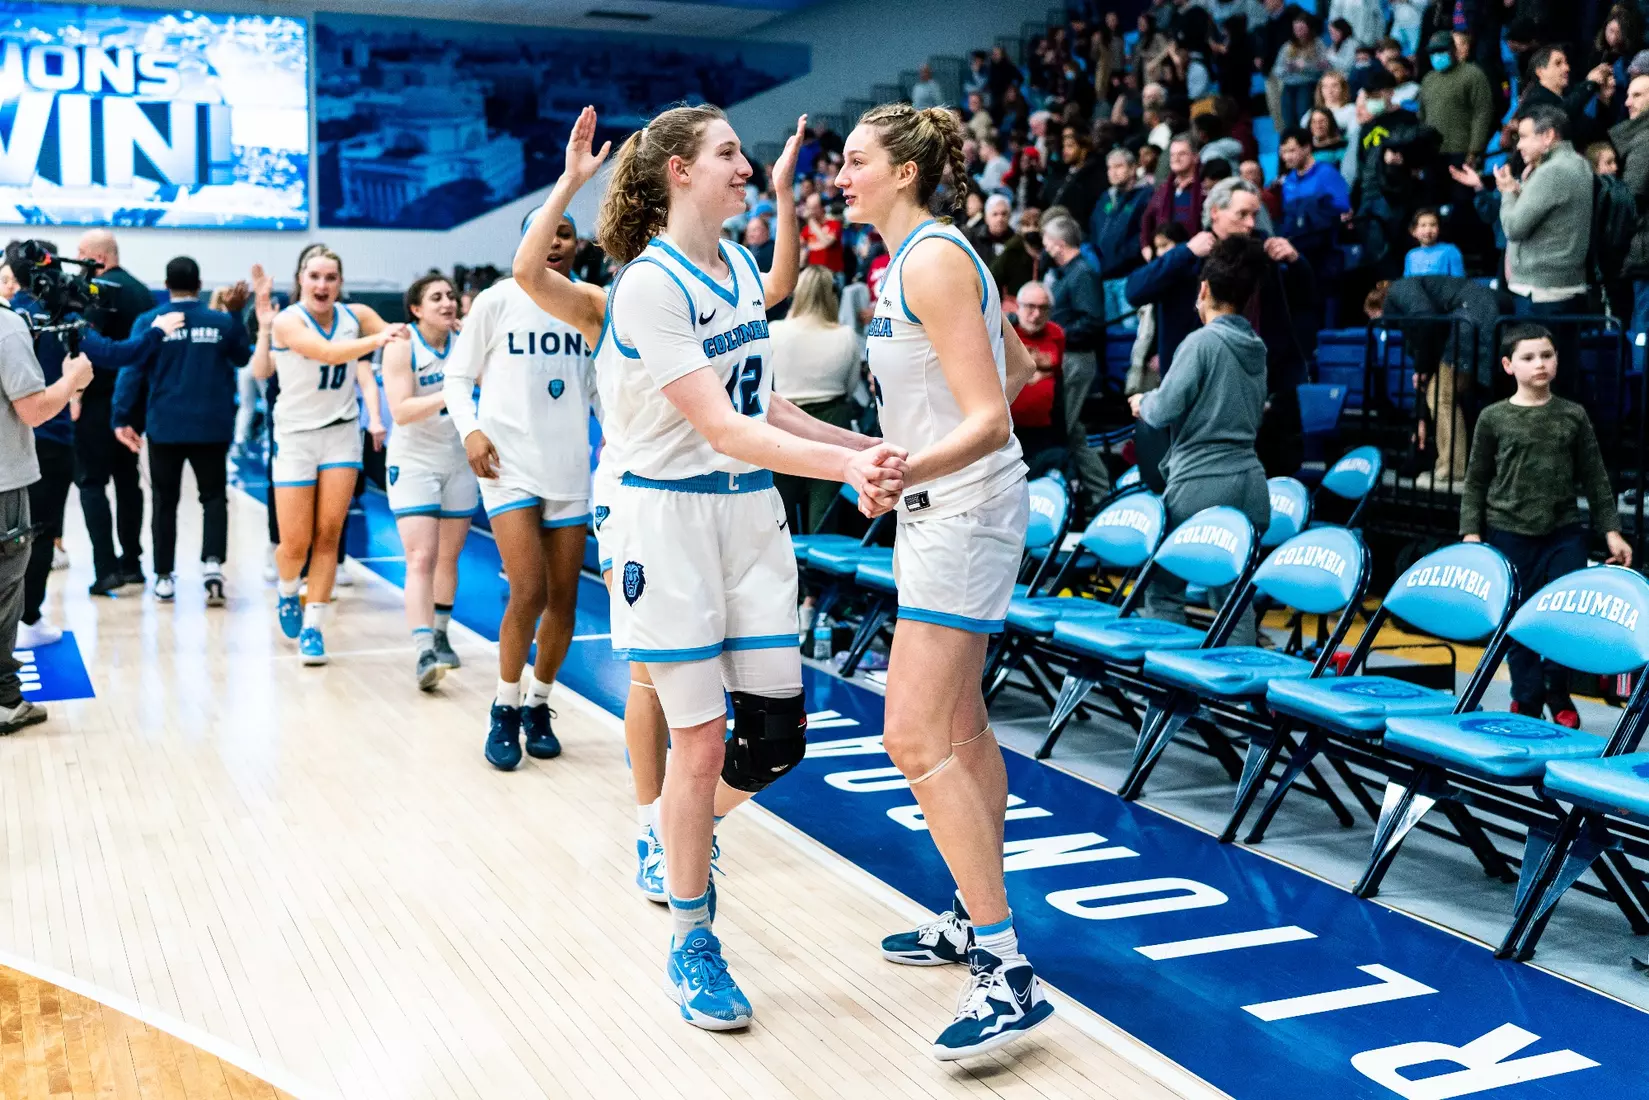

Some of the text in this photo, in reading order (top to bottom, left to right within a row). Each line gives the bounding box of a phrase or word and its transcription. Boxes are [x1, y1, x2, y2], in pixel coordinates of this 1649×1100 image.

[0, 43, 180, 95] IONS
[318, 362, 348, 391] 10
[1096, 509, 1151, 535] COLUMBIA
[1174, 525, 1239, 554] COLUMBIA
[1273, 545, 1347, 578] COLUMBIA
[1406, 565, 1492, 601] COLUMBIA
[1535, 589, 1640, 632] COLUMBIA
[1003, 831, 1440, 1022] LION
